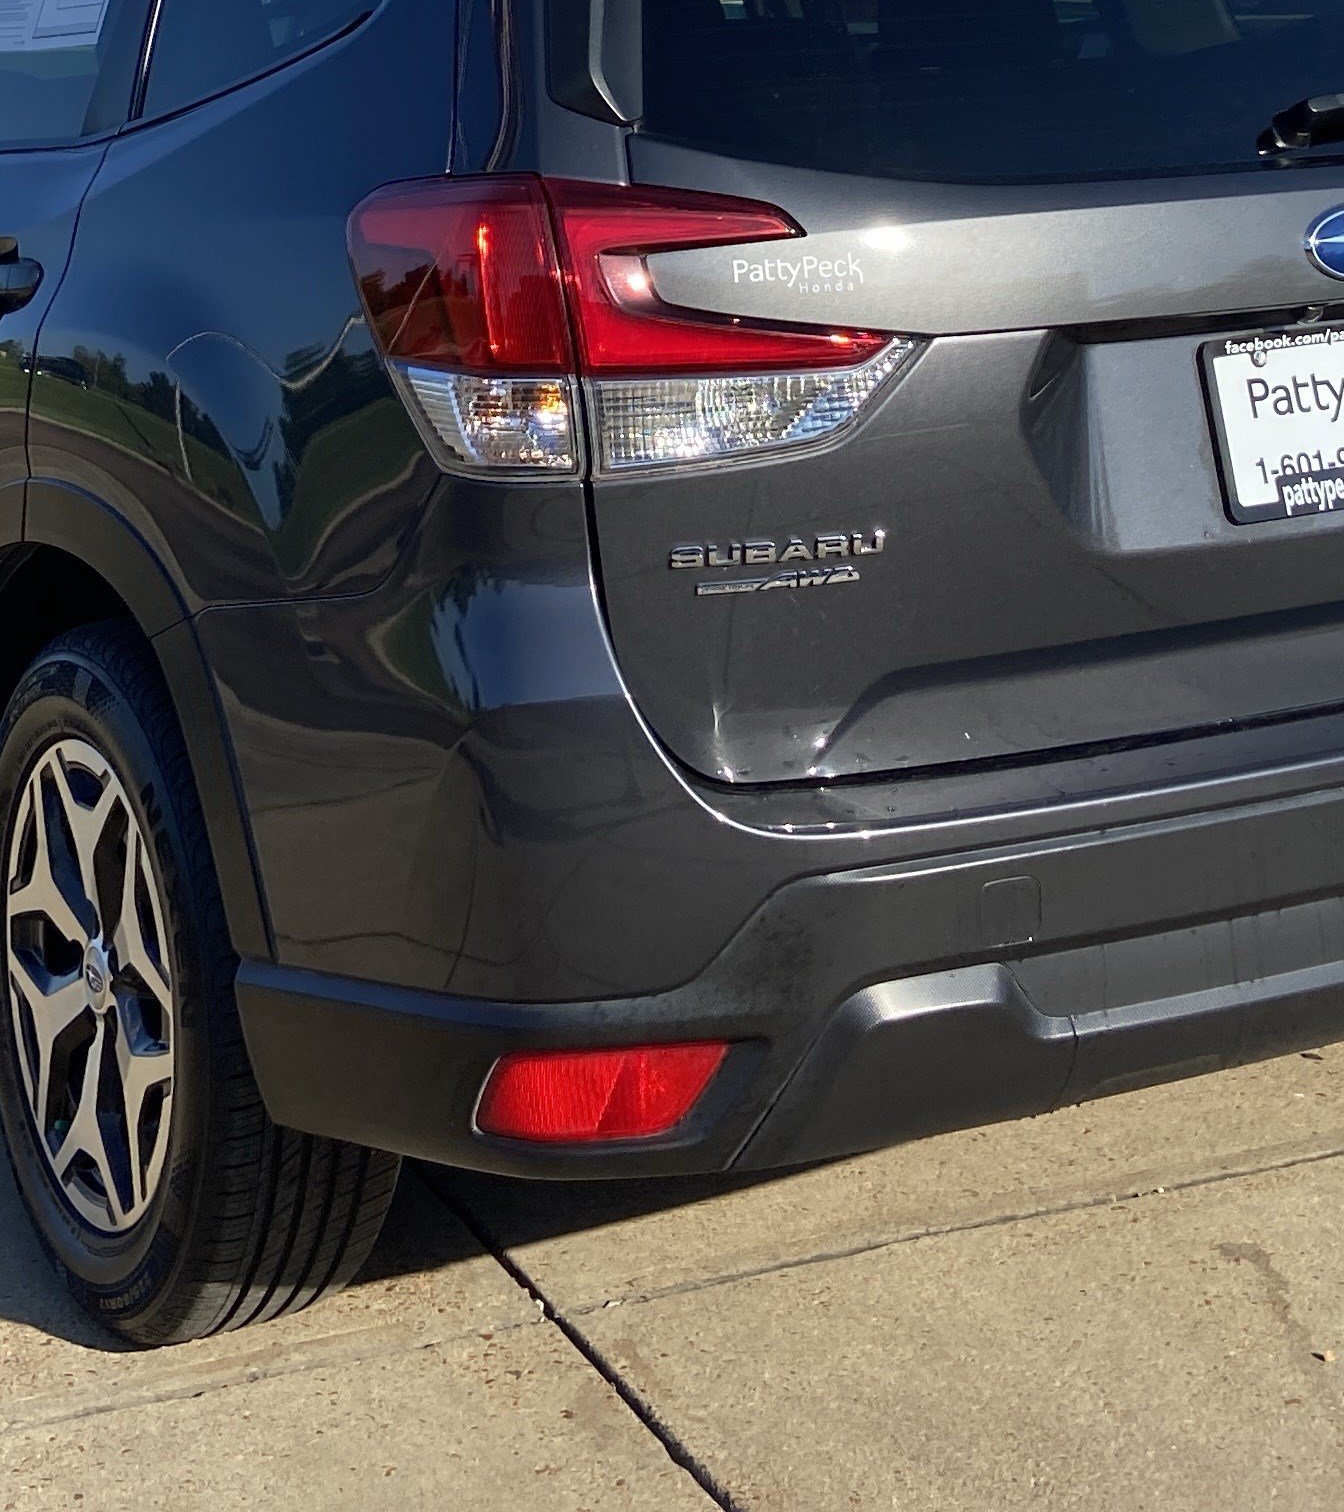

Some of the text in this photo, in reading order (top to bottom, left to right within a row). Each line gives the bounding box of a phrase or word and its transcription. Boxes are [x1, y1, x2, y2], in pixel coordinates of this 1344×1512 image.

[732, 251, 864, 288] PattyPeck
[799, 280, 854, 294] Honda
[670, 529, 886, 569] SUBARU
